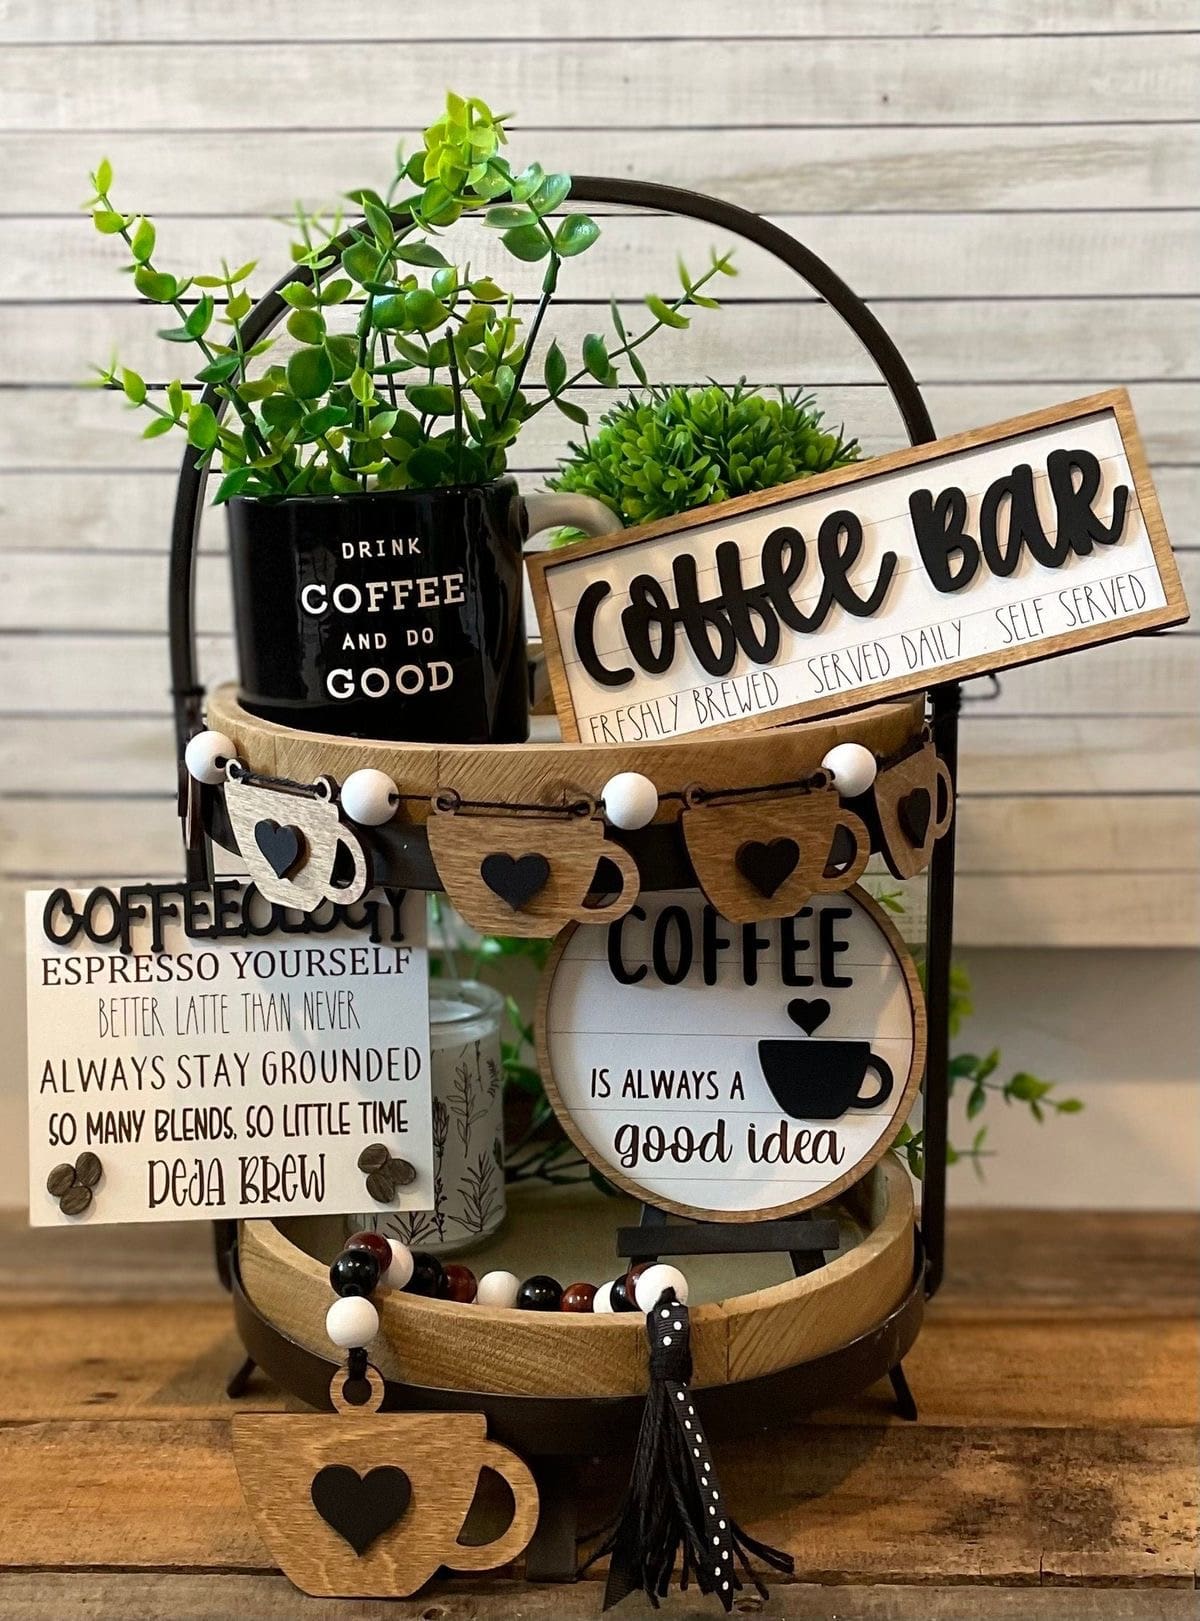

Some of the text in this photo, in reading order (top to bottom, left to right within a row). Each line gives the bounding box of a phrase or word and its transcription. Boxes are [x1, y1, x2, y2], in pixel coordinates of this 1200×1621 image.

[342, 538, 421, 559] DRINK
[301, 573, 465, 615] COFFEE
[342, 628, 434, 650] AND DO
[589, 574, 1146, 743] FRESHLY BREWED SERVED DAILY SELF SERVED
[326, 661, 454, 699] GOOD
[41, 946, 412, 986] ESPRESSO YOURSELF
[607, 904, 853, 988] COFFEE
[99, 990, 360, 1038] BETTER LATTE THAN NEVER
[40, 1046, 421, 1094] ALWAYS STAY GROUNDED
[591, 1068, 745, 1101] IS ALWAYS A
[49, 1100, 408, 1146] SO MANY BLENDS, SO LITTLE TIME
[614, 1118, 846, 1168] good idea
